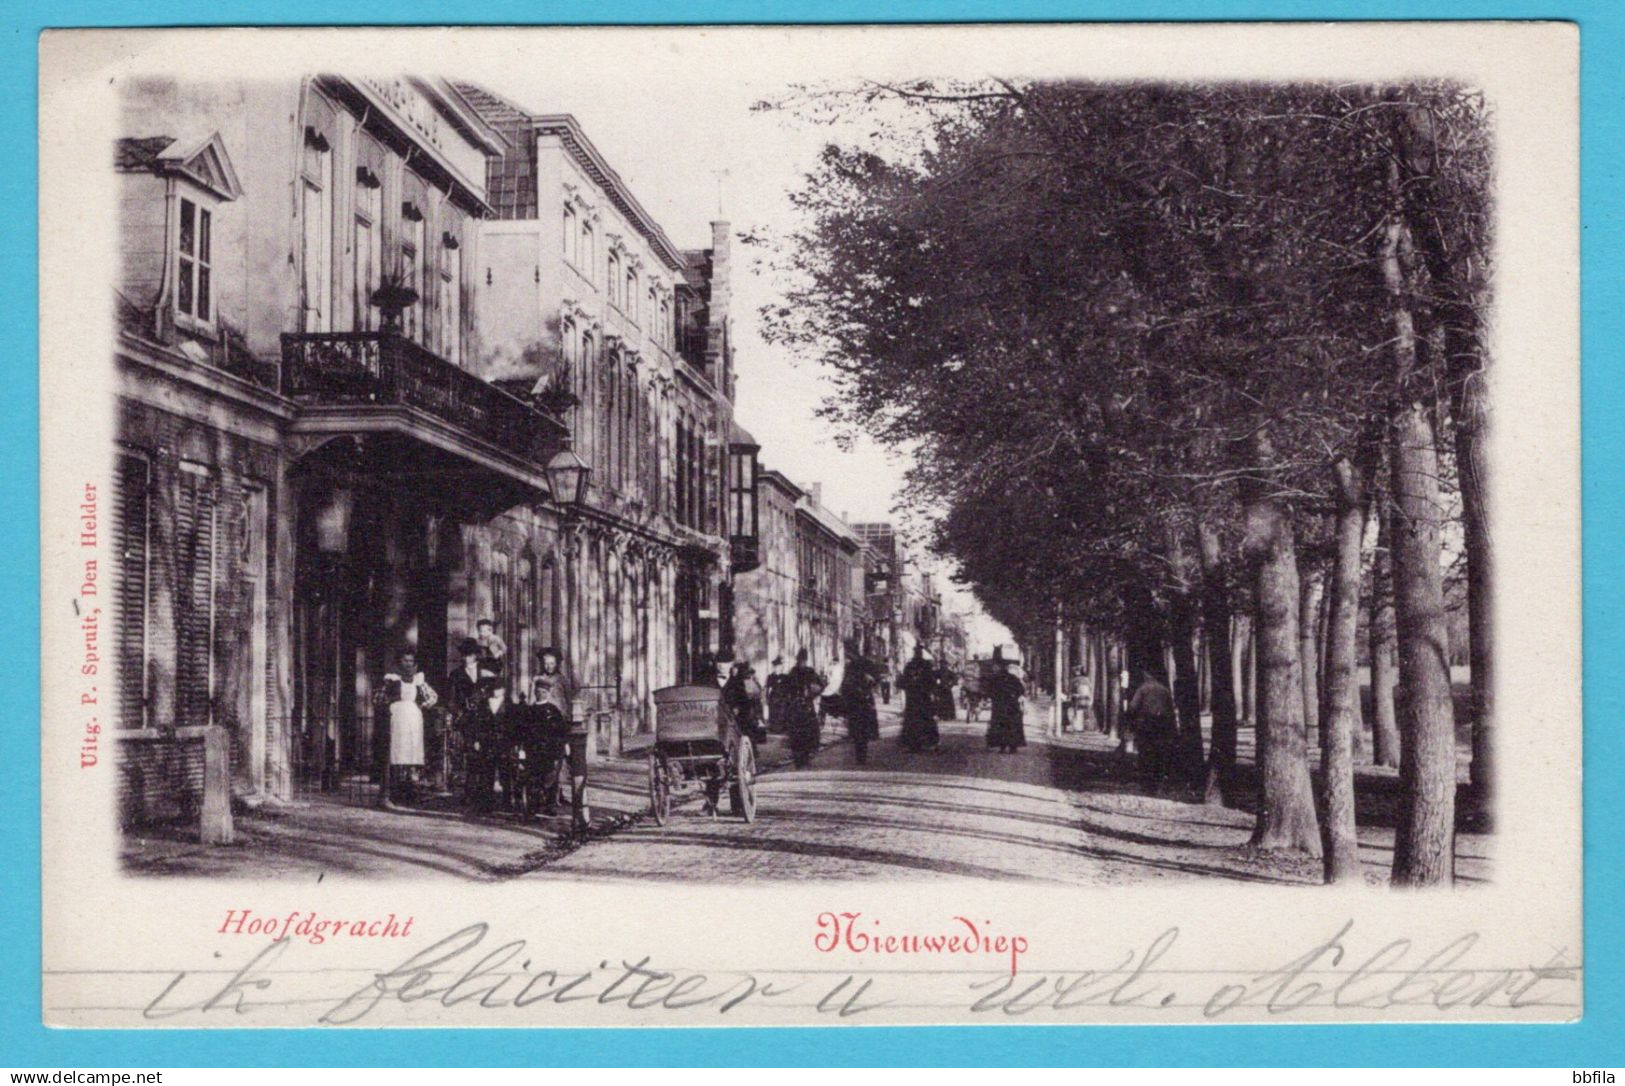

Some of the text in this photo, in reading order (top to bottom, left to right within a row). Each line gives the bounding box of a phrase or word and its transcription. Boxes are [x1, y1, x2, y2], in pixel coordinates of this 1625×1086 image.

[79, 483, 102, 769] Uitg. P. Spruit, Den Helder
[217, 908, 415, 945] Hoofdgracht
[814, 911, 1029, 977] Nieuwediep
